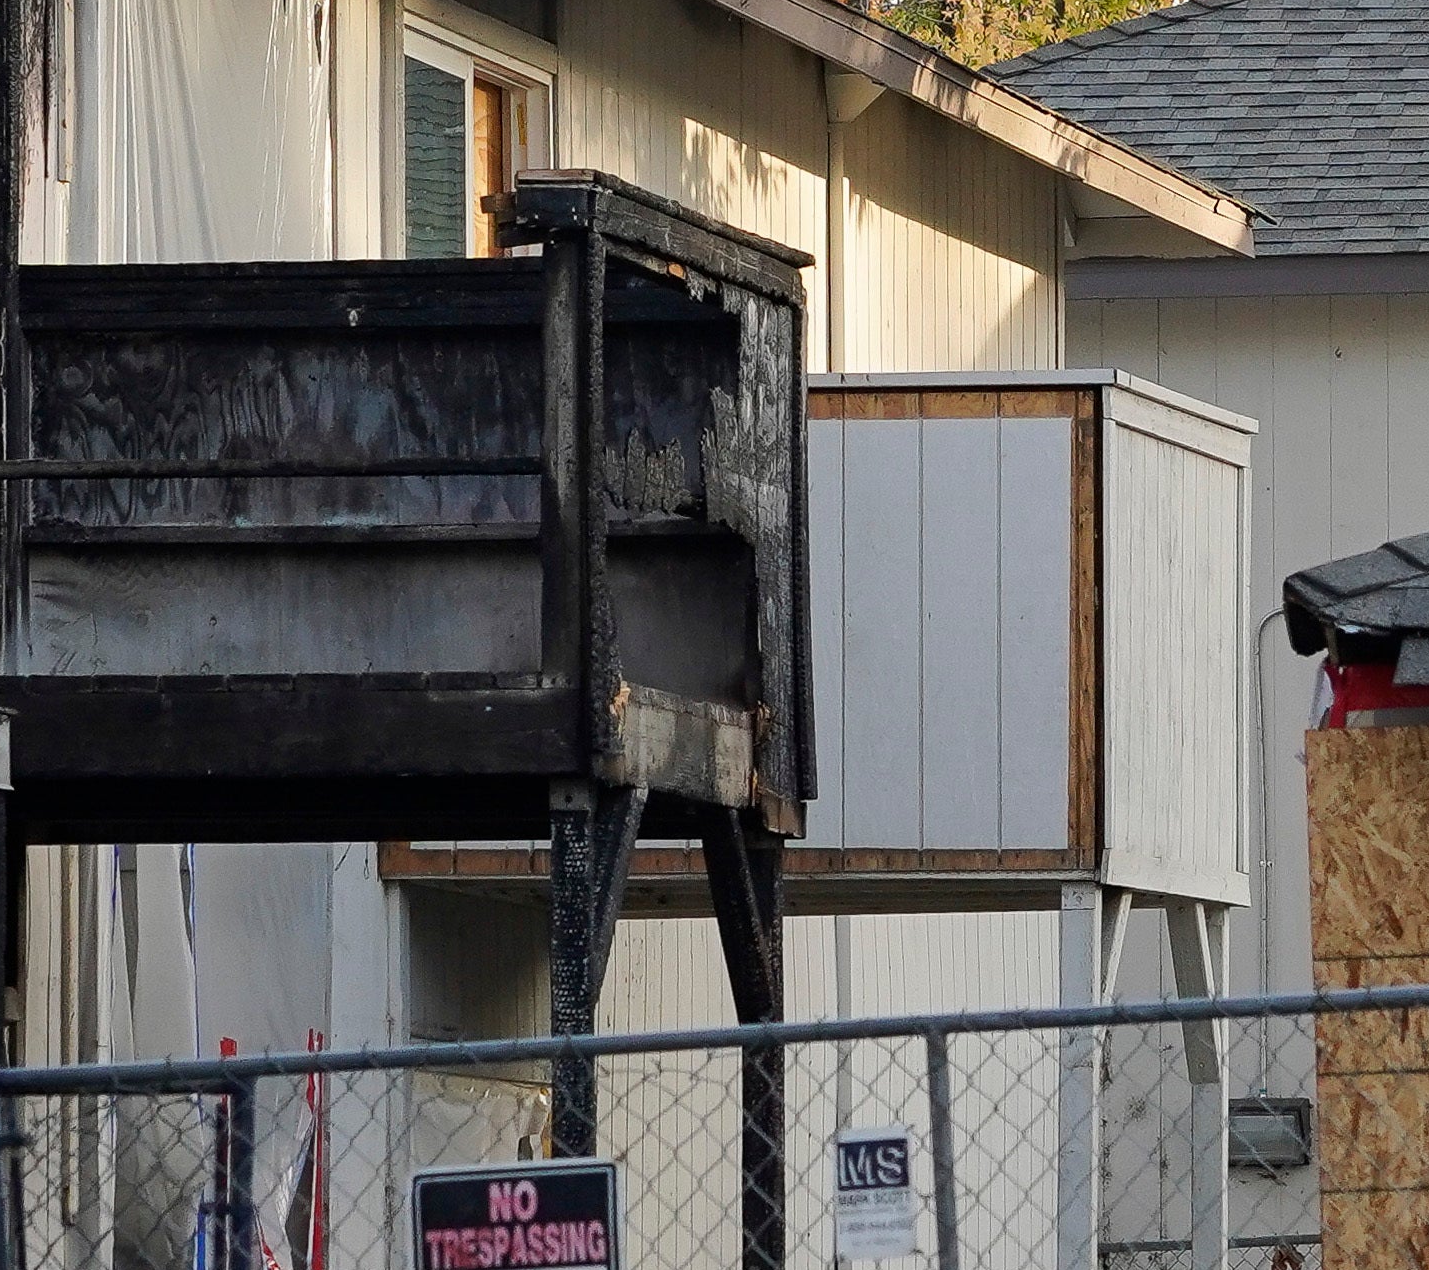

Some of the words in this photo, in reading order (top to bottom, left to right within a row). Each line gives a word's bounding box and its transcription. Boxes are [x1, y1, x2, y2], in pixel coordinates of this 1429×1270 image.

[839, 1145, 905, 1186] MS
[488, 1179, 539, 1223] NO
[425, 1218, 607, 1270] TRESPASSING
